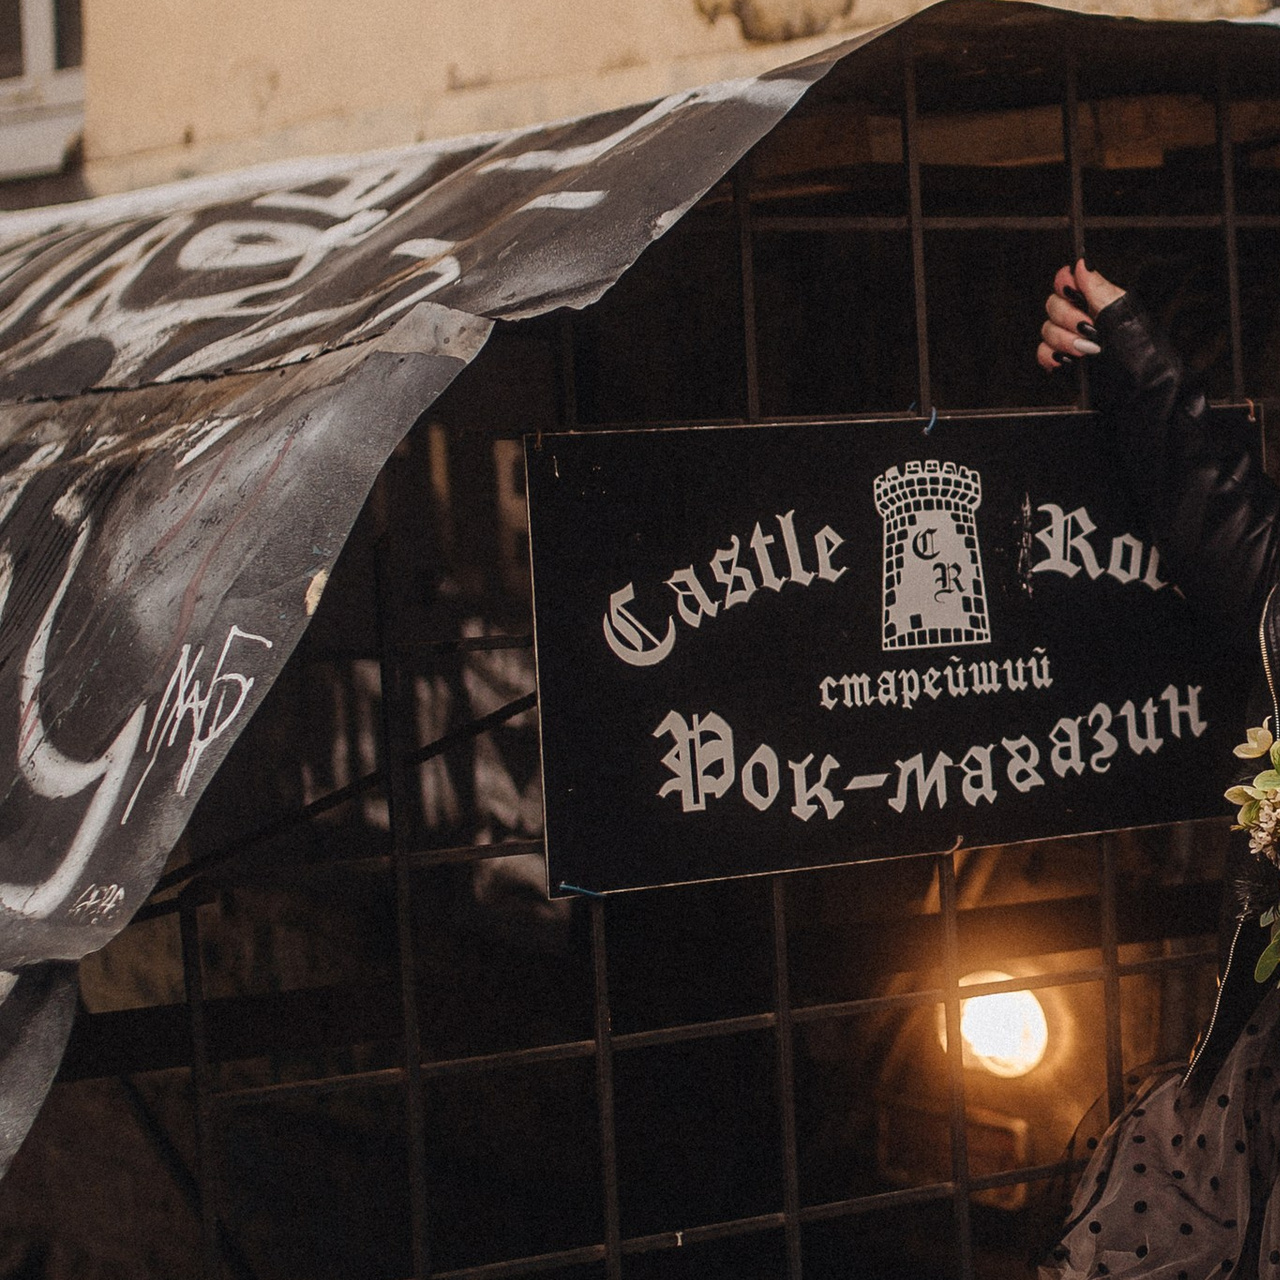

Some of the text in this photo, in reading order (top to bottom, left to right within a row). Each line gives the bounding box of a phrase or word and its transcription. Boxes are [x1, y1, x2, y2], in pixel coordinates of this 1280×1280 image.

[602, 508, 850, 667] Castle
[818, 646, 1055, 711] старейший
[651, 683, 1208, 822] Рок-магазин
